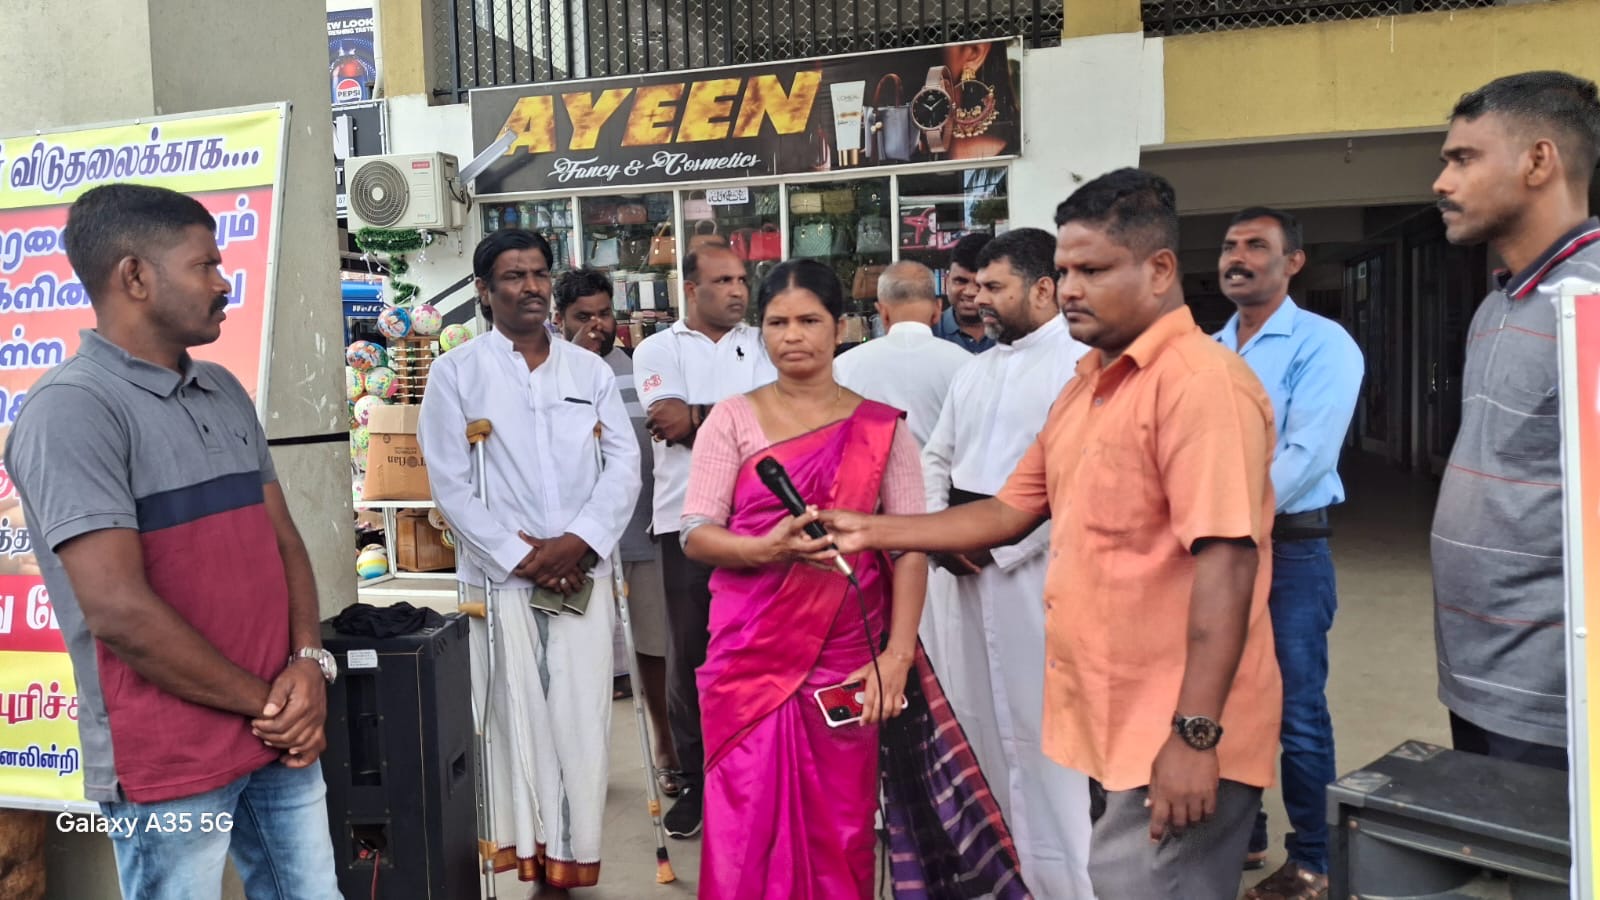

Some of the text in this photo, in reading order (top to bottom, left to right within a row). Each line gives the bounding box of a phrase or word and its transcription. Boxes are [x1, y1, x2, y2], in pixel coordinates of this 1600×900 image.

[338, 89, 361, 97] PEPSI
[495, 70, 823, 156] AYEEN
[547, 150, 761, 183] Fancy & Cosmetics
